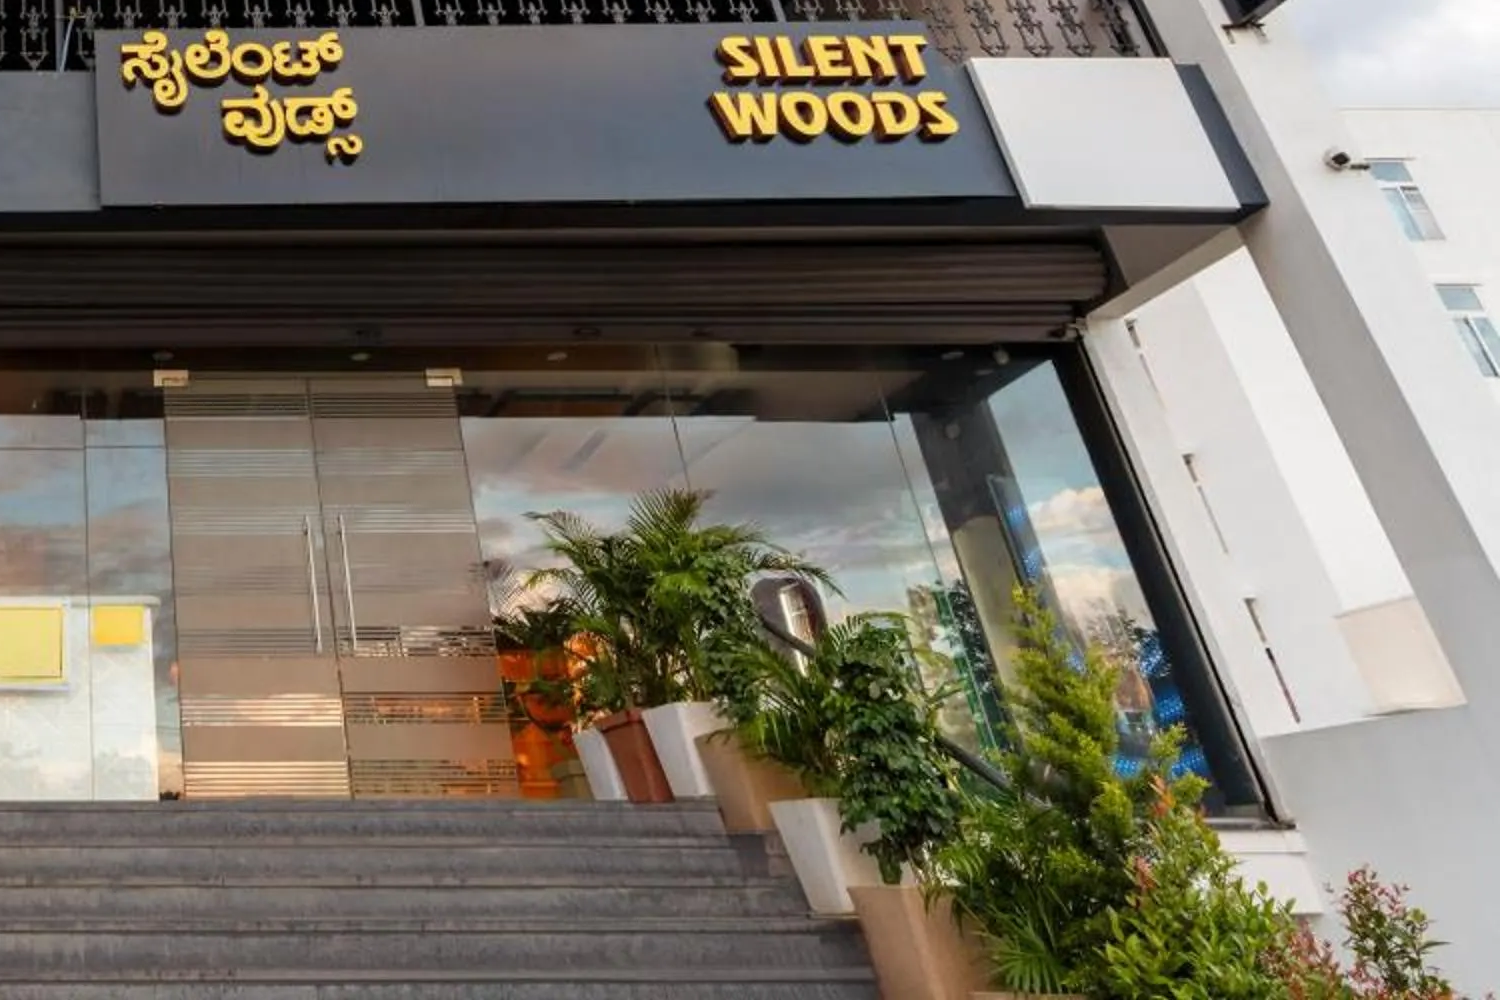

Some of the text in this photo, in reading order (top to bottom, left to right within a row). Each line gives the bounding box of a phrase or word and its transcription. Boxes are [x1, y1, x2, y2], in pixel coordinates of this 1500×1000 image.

[120, 29, 345, 110] ಸೈಲೆಂಟ್
[717, 35, 929, 82] SILENT
[220, 84, 364, 158] ವುಡ್ಸ್
[710, 91, 960, 141] WOODS
